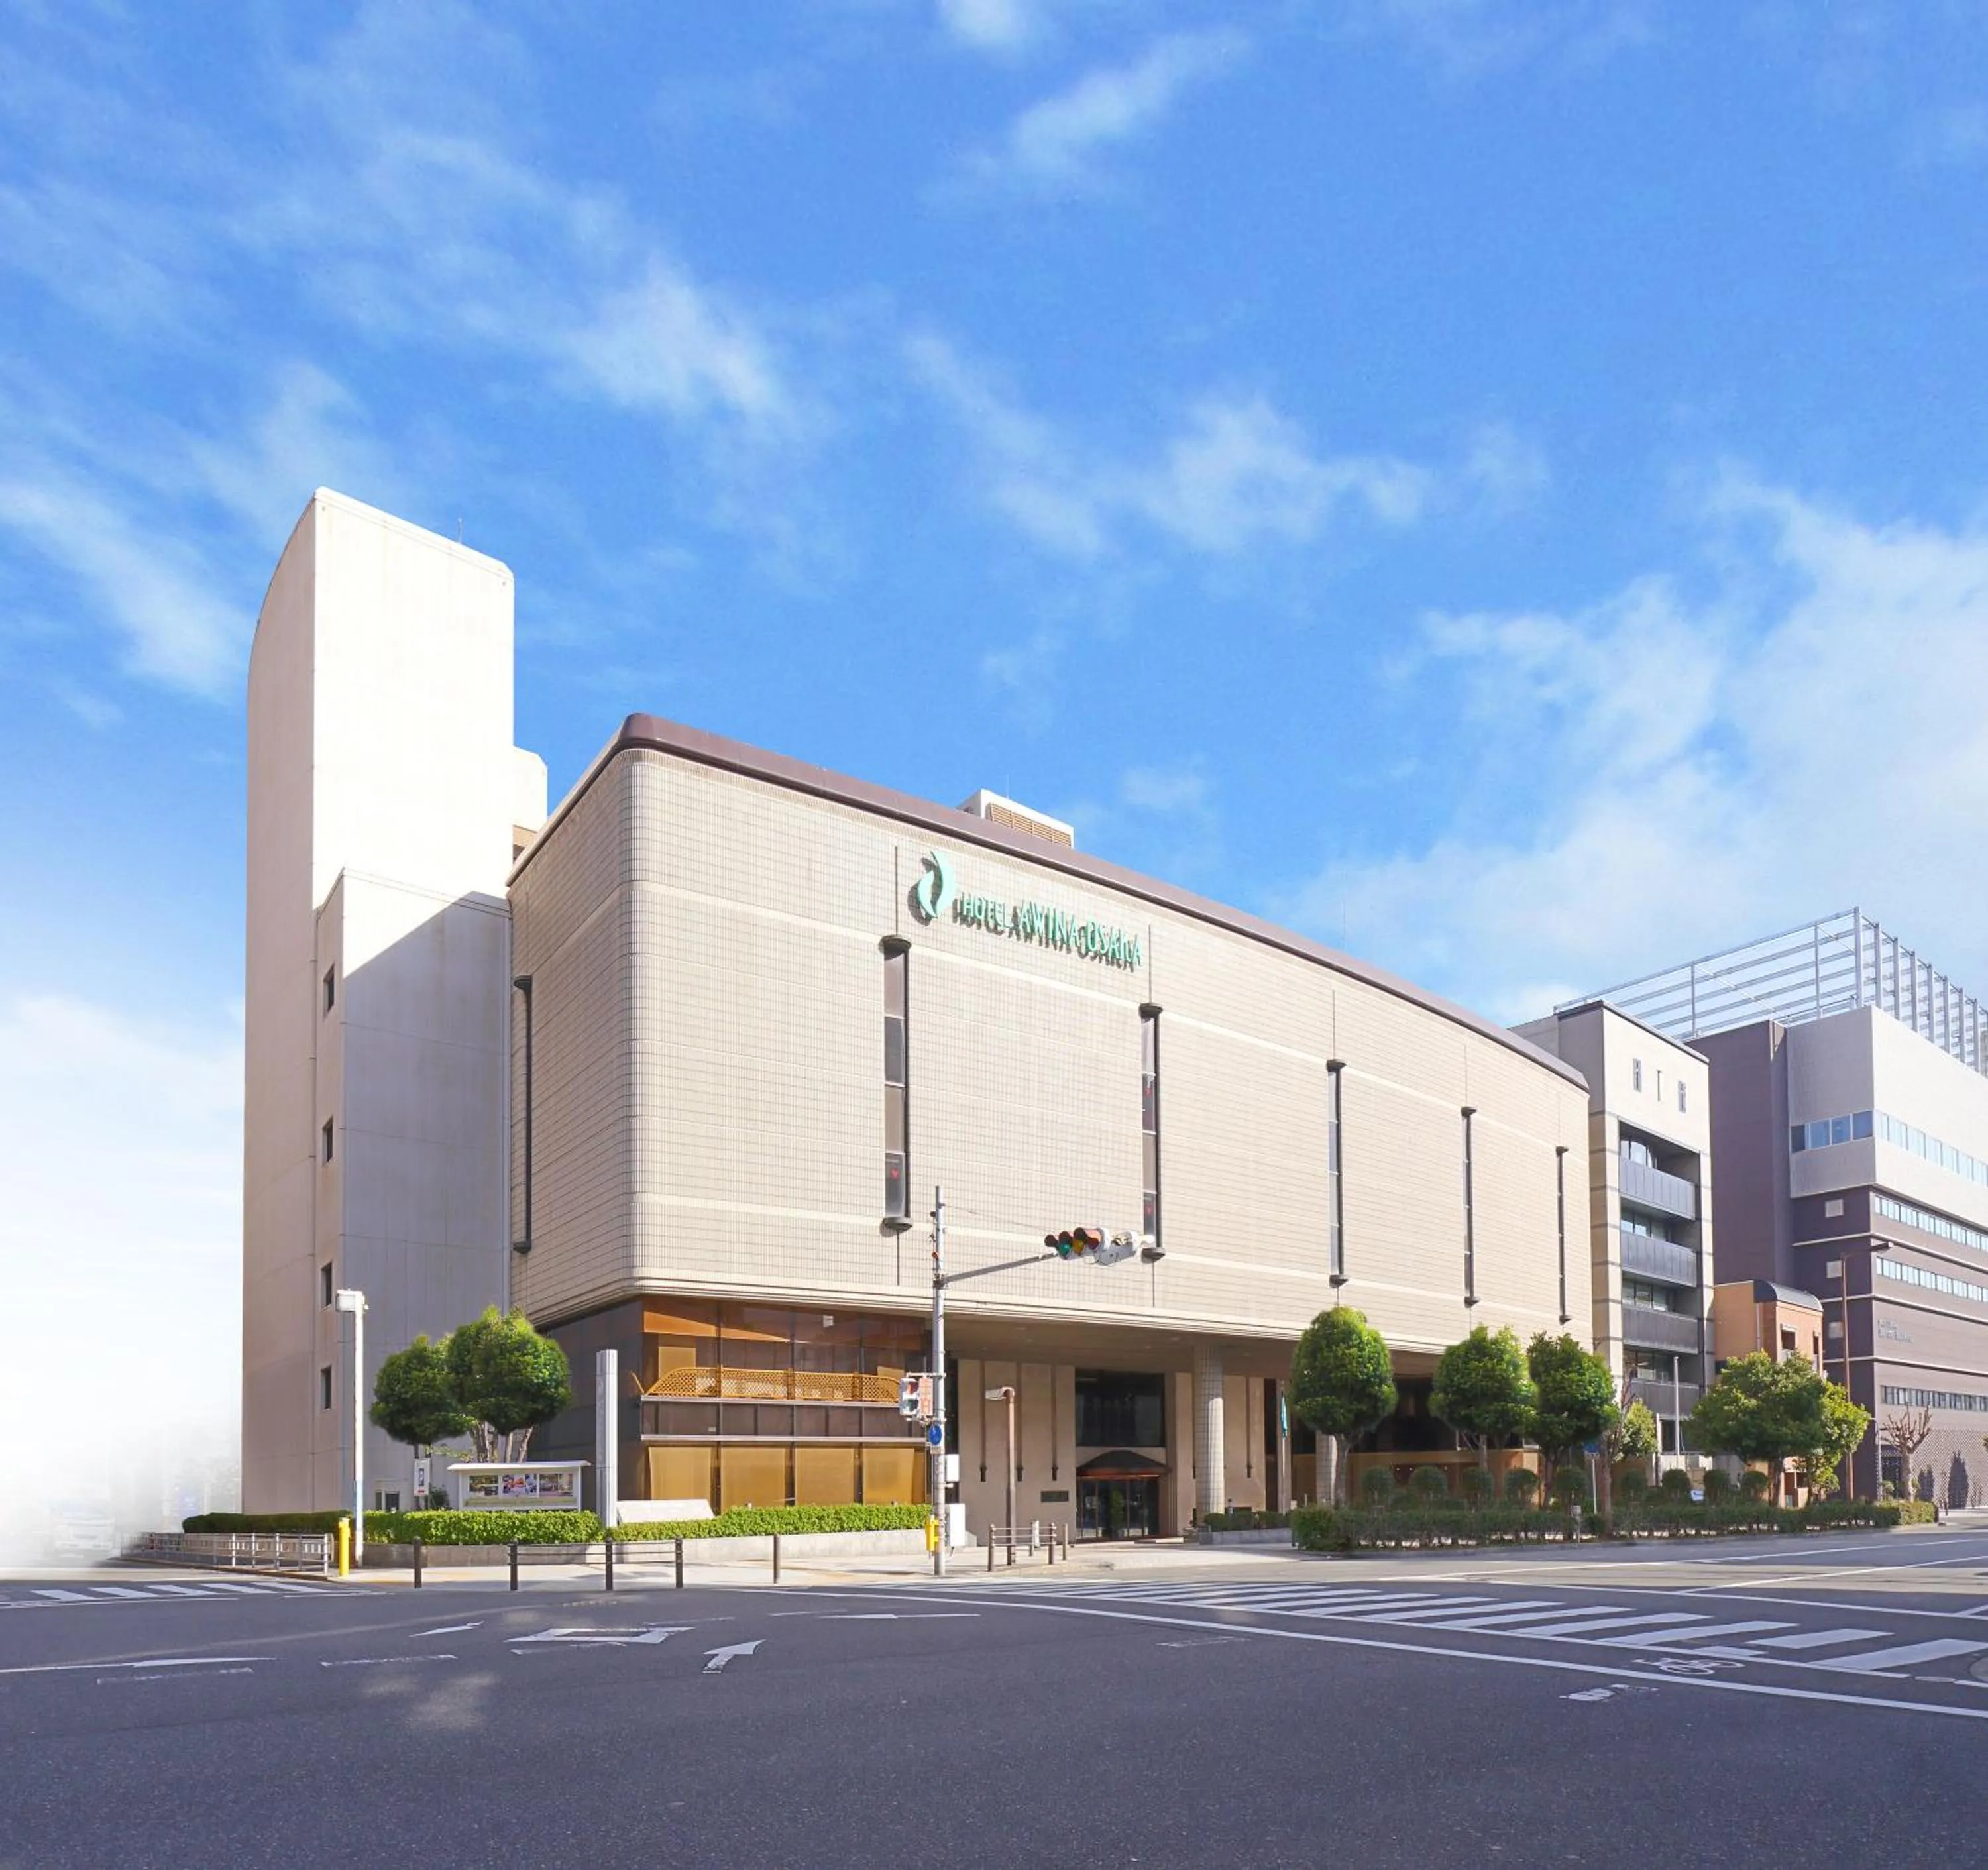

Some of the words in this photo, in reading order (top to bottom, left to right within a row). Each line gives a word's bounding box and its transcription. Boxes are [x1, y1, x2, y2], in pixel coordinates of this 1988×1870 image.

[962, 893, 1013, 928] HOTEL
[1019, 901, 1081, 947] AWINA
[1085, 917, 1143, 965] OSAKA
